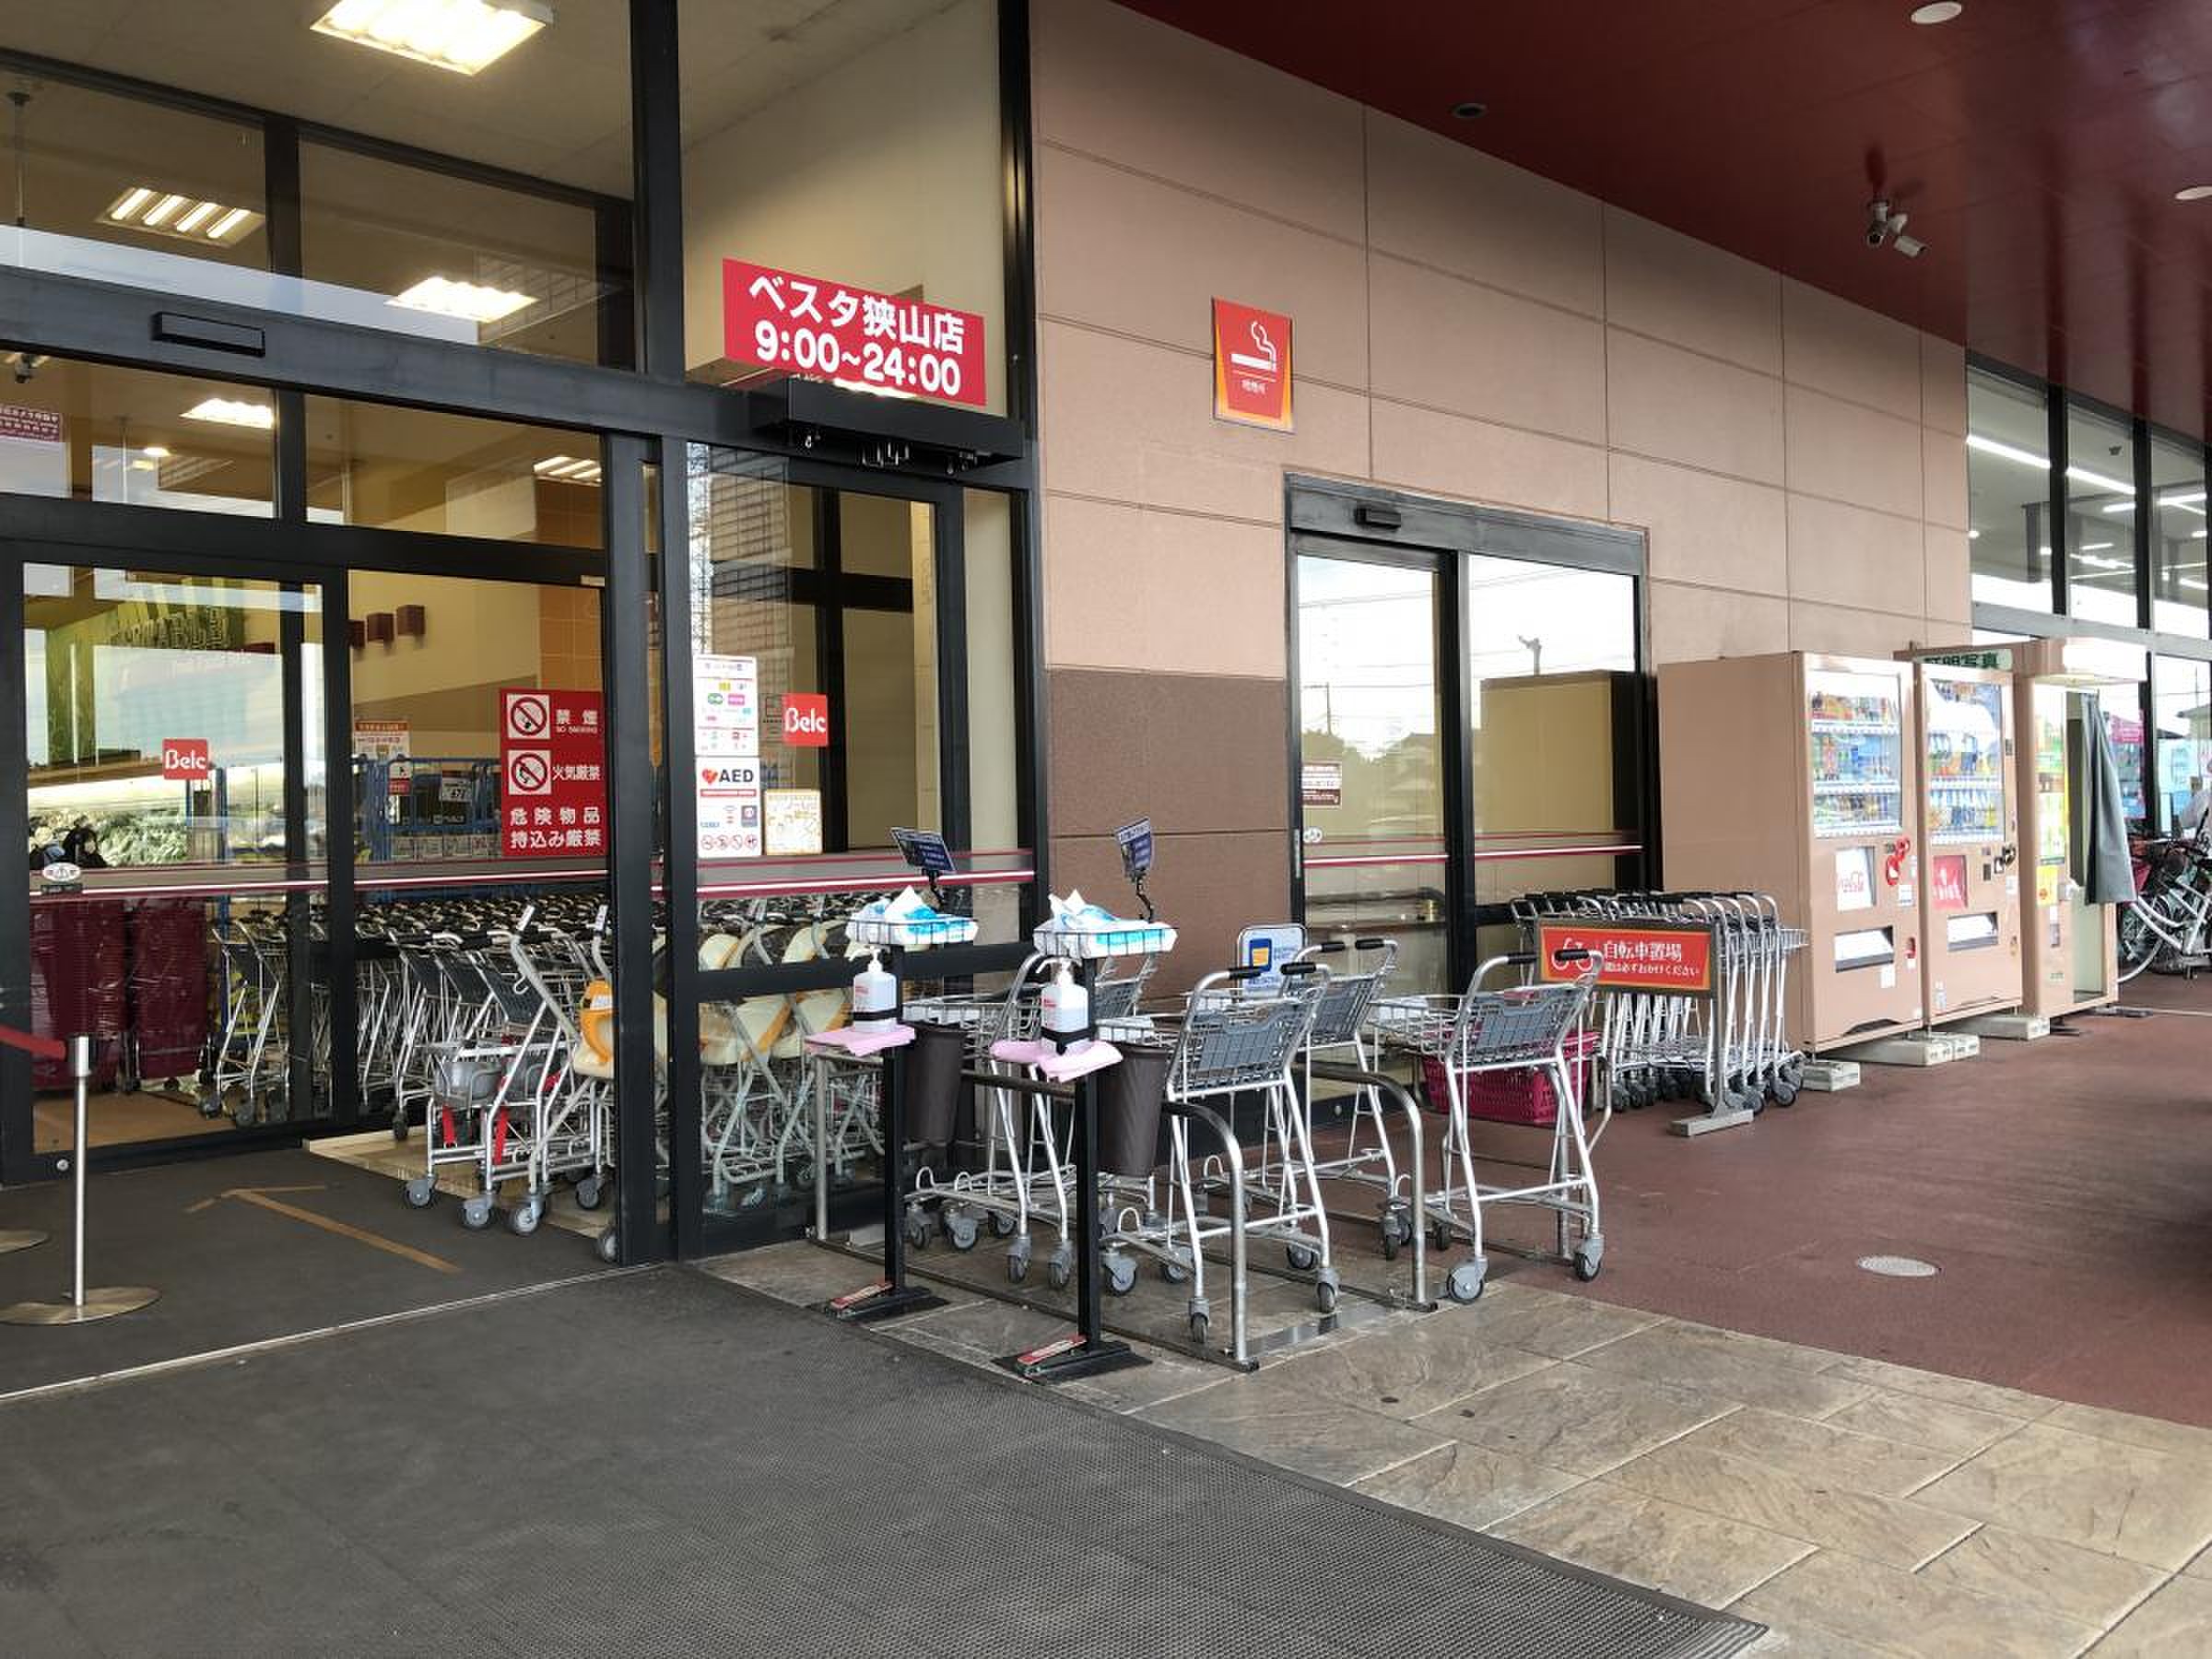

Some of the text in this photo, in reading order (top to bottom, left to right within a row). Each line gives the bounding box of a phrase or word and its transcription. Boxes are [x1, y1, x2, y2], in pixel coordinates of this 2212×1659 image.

[749, 276, 965, 355] ベスタ狭山店
[555, 709, 598, 725] 禁煙
[785, 707, 826, 733] Belc
[166, 749, 206, 770] Belc
[552, 765, 601, 782] 火気厳禁
[719, 769, 754, 782] AED
[510, 806, 600, 827] 危険物品
[511, 830, 601, 849] 持込み厳禁
[1603, 940, 1682, 962] 自転車置場
